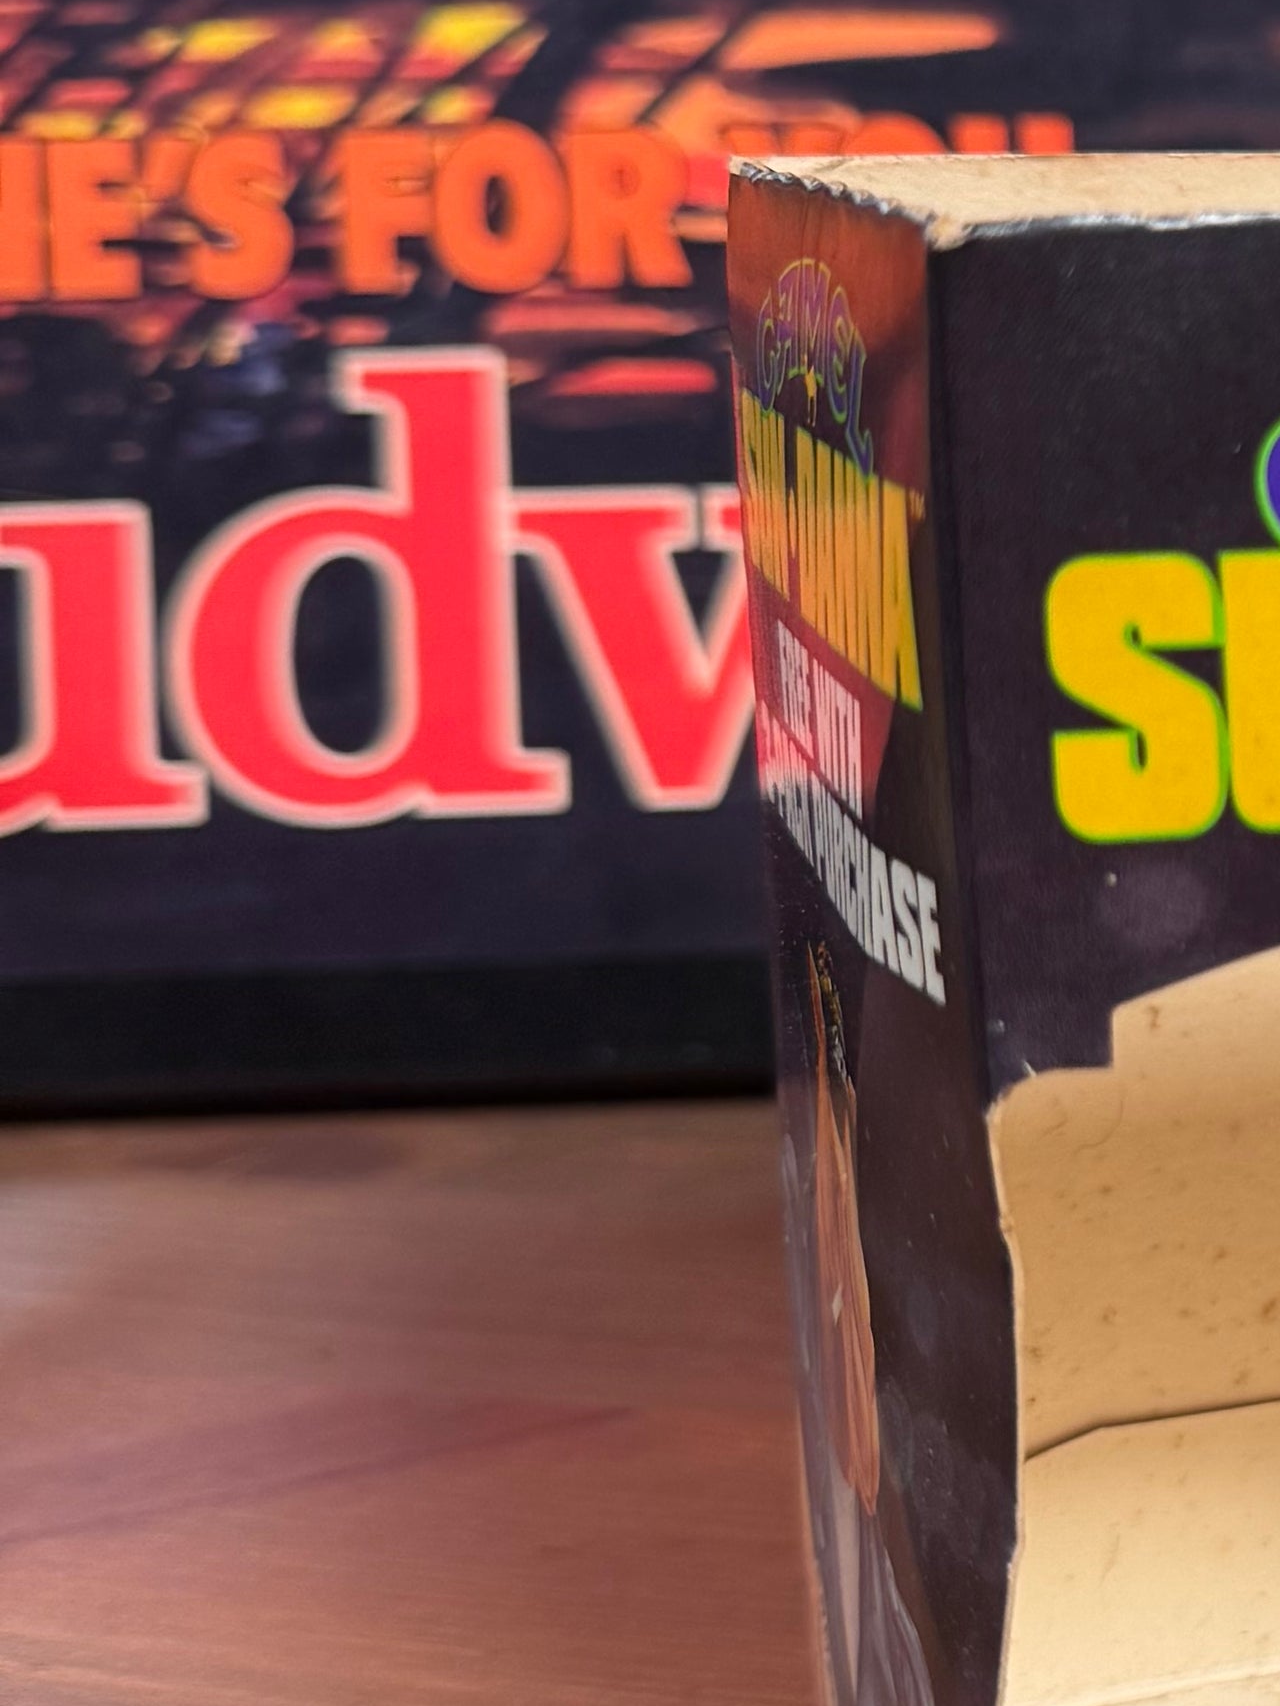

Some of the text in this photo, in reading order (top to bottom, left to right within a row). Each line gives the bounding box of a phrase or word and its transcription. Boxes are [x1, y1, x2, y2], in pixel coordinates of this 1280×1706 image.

[333, 119, 695, 295] FOR
[812, 662, 863, 822] WITH
[811, 765, 946, 1007] PURCHASE
